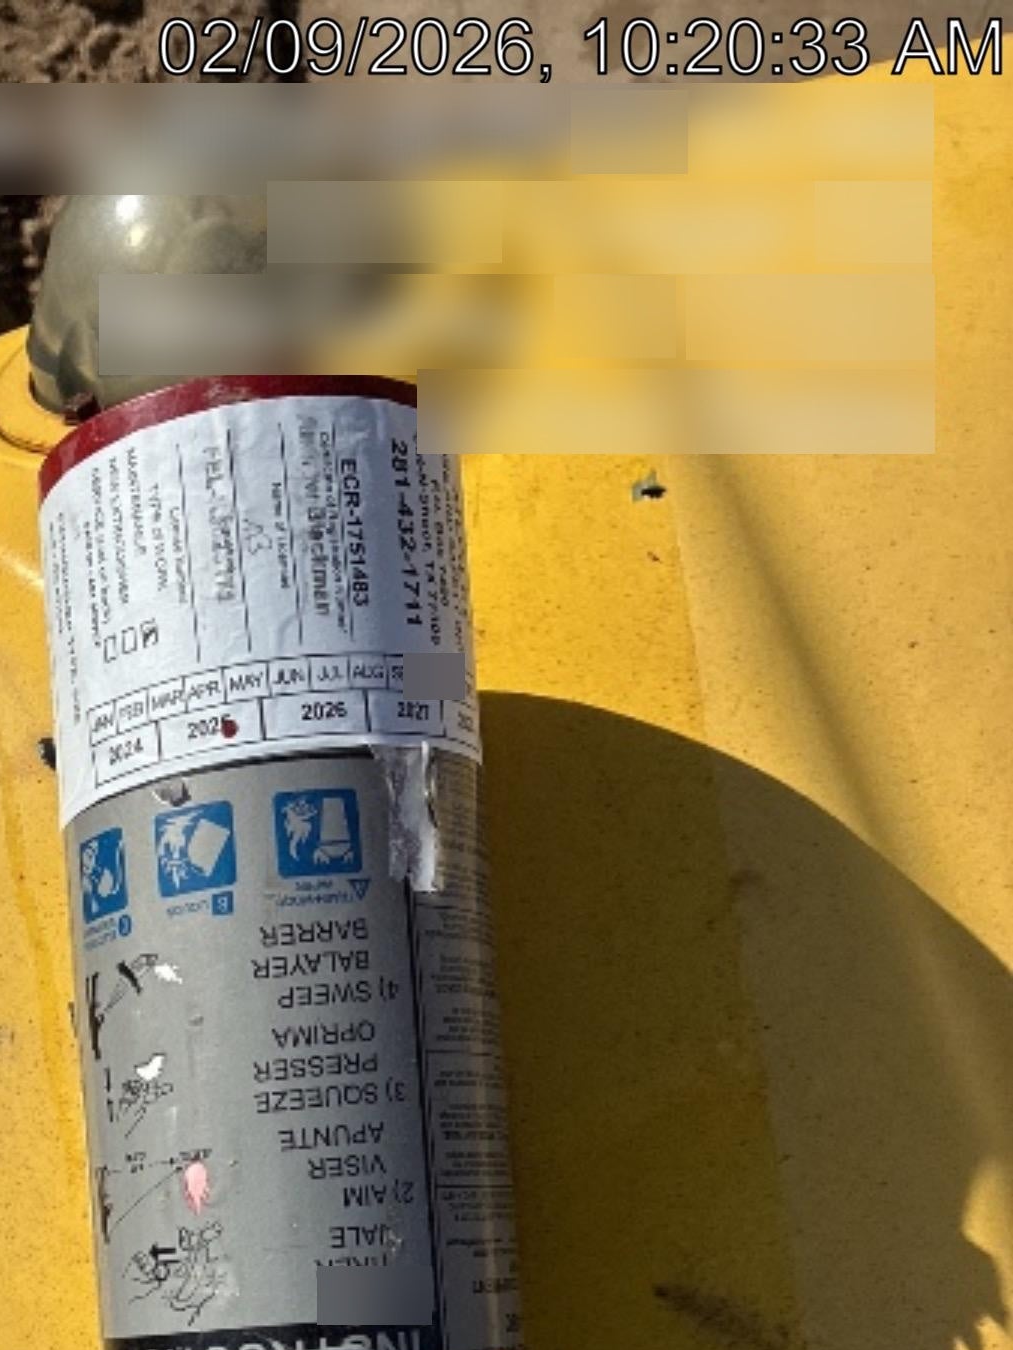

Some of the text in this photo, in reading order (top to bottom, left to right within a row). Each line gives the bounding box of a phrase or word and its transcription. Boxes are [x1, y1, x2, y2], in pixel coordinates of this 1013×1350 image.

[340, 458, 368, 607] ECR-1751483
[390, 438, 423, 626] 281-432-1711
[188, 679, 222, 700] APR
[229, 671, 264, 693] MAY
[273, 666, 306, 685] JUN
[317, 664, 344, 682] JUL
[353, 662, 385, 680] AUG
[301, 701, 348, 721] 2026
[259, 917, 368, 948] BARRER
[250, 949, 369, 979] BALAYER
[277, 975, 399, 1009] 4) SWEEP
[270, 1019, 375, 1050] OPRIMA
[252, 1052, 378, 1083] PRESSER
[253, 1082, 379, 1113] SQUEEZE
[384, 1076, 404, 1102] 3)
[277, 1121, 384, 1152] APUNTE
[307, 1153, 387, 1179] VISER
[342, 1178, 414, 1207] 2) AIM
[329, 1223, 388, 1248] JALE
